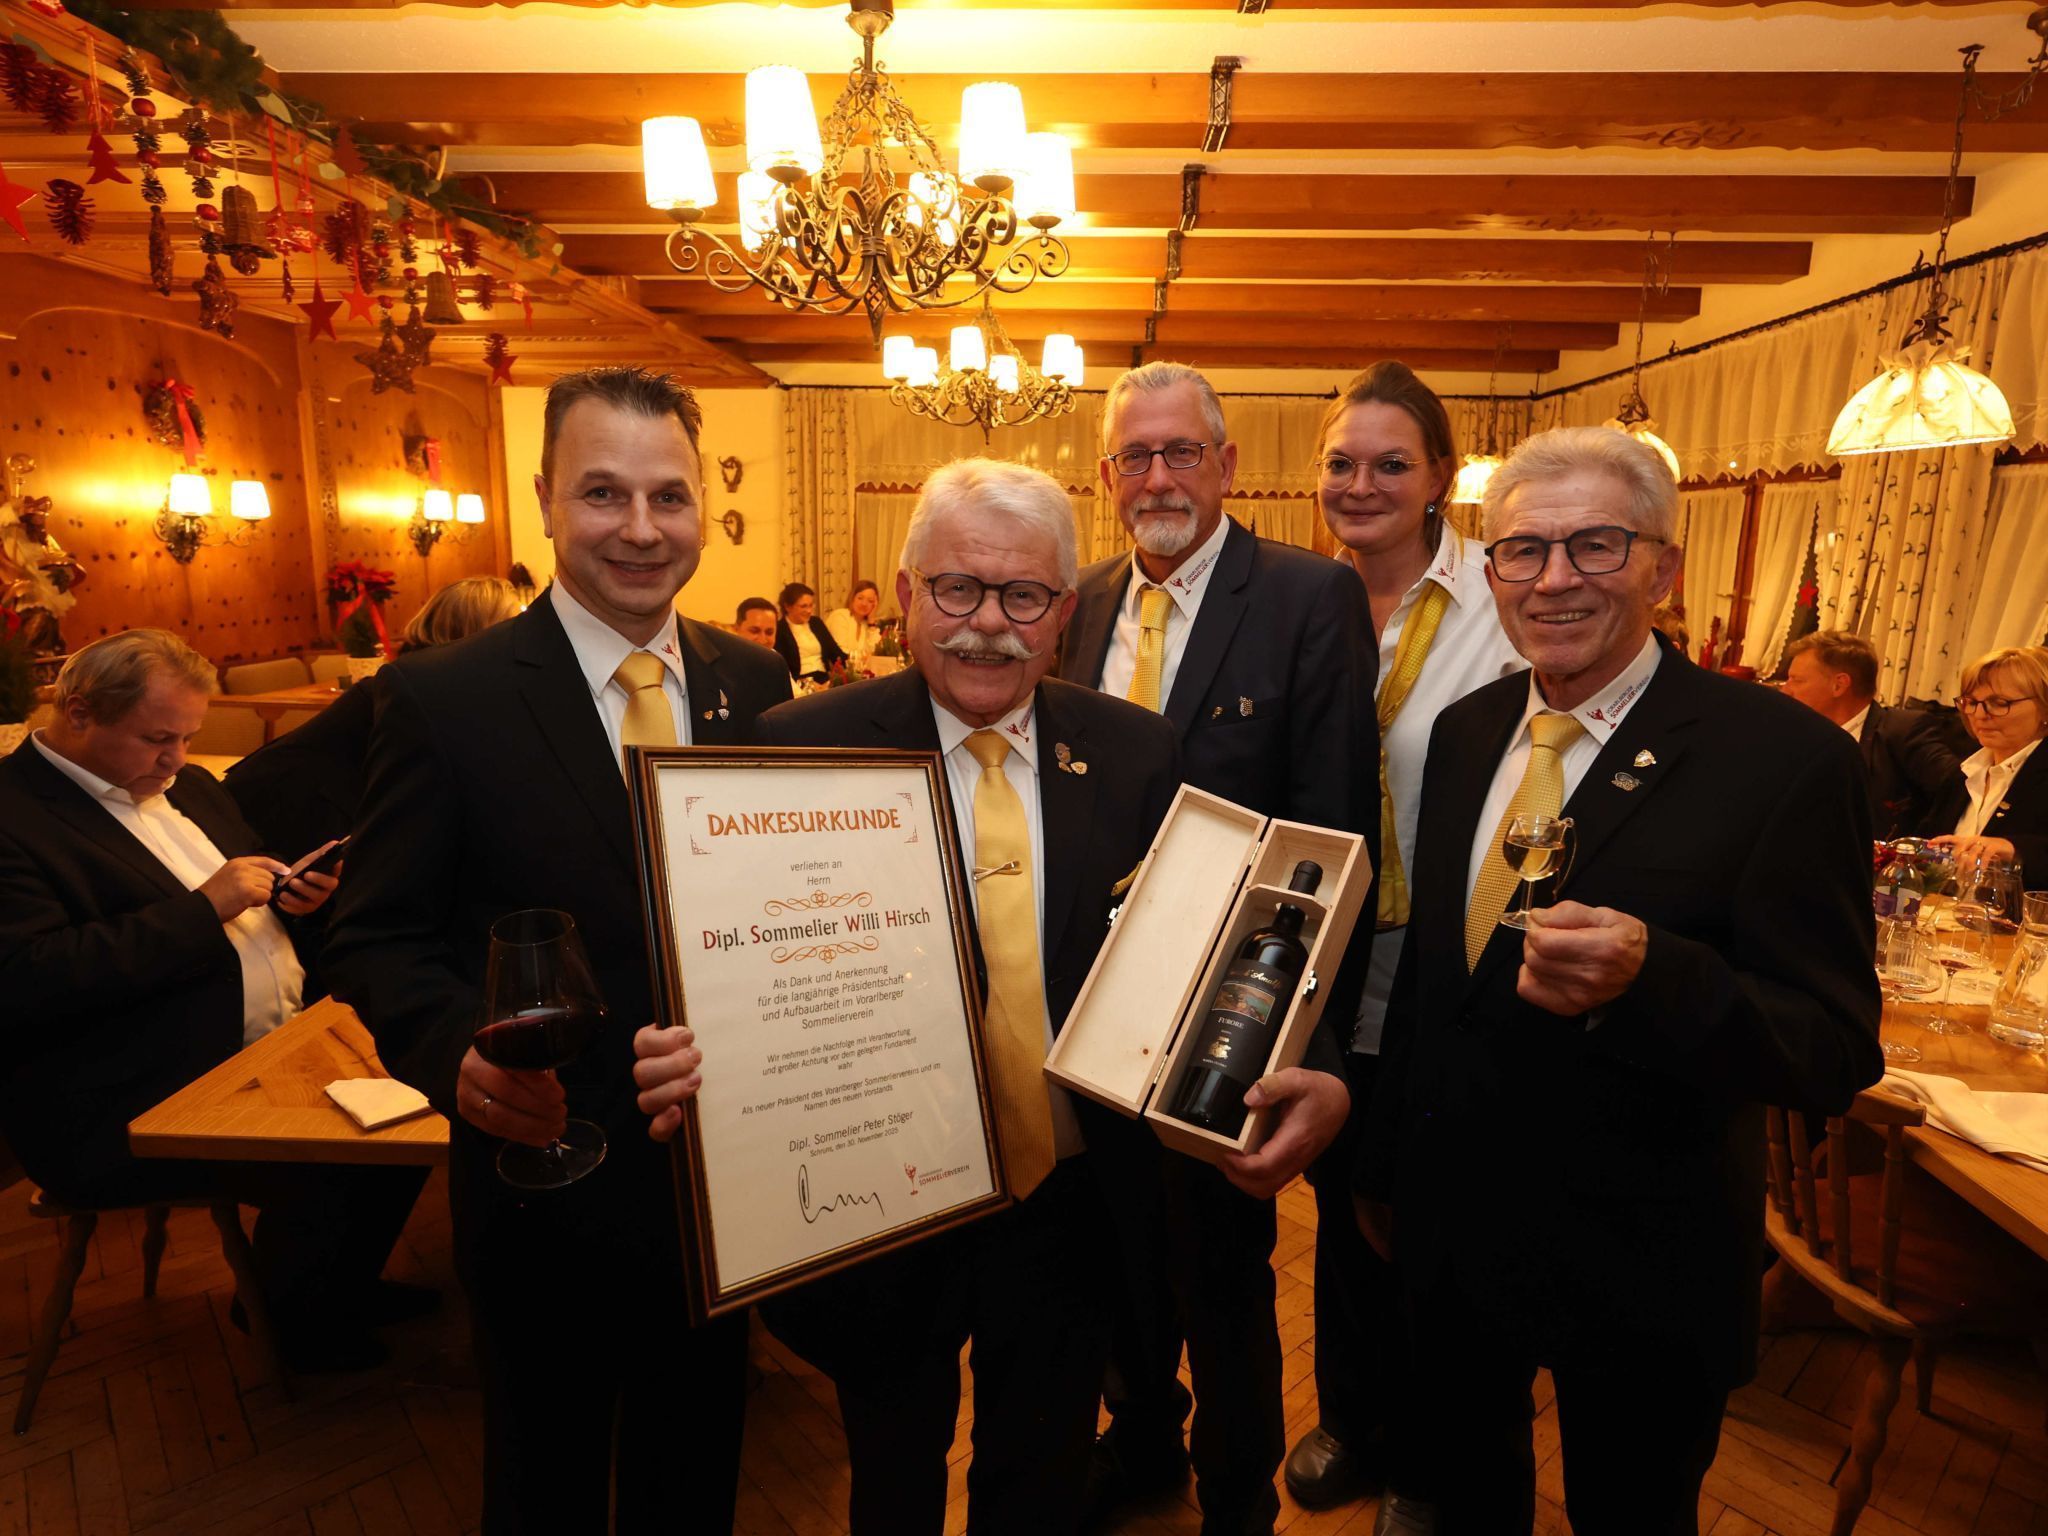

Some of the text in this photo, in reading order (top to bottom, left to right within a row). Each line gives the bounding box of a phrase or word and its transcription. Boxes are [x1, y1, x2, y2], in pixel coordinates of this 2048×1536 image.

[1610, 676, 1650, 718] SOMMELIERVEREIN
[707, 808, 900, 836] DANKESURKUNDE
[790, 860, 842, 872] verliehen an
[807, 876, 830, 886] Herrn
[703, 908, 930, 951] Dipl. Sommelier Willi Hirsch
[758, 975, 904, 1007] für die langjährige Präsidentschaft
[773, 965, 888, 990] Als Dank und Anerkennung
[763, 990, 904, 1021] und Aufbauarbeit im Vorarlberger
[802, 1009, 873, 1029] Sommelierverein
[763, 1066, 776, 1076] und
[778, 1062, 799, 1074] großer
[801, 1056, 828, 1067] Achtung
[842, 1050, 855, 1059] dem
[857, 1044, 883, 1057] gelegten
[884, 1037, 916, 1050] Fundament
[767, 1028, 910, 1063] Wir nehmen die Nachfolge mit Verantwortung
[837, 1061, 853, 1071] wahr
[742, 1107, 753, 1115] Als
[755, 1101, 775, 1112] neuer
[777, 1093, 809, 1107] Präsident
[811, 1088, 823, 1098] des
[921, 1065, 932, 1073] und
[804, 1084, 893, 1112] Namen des neuen Vorstands
[789, 1111, 913, 1152] Dipl. Sommelier Peter Stöger
[858, 1132, 883, 1144] November
[919, 1164, 970, 1186] SOMMELIERVEREIN
